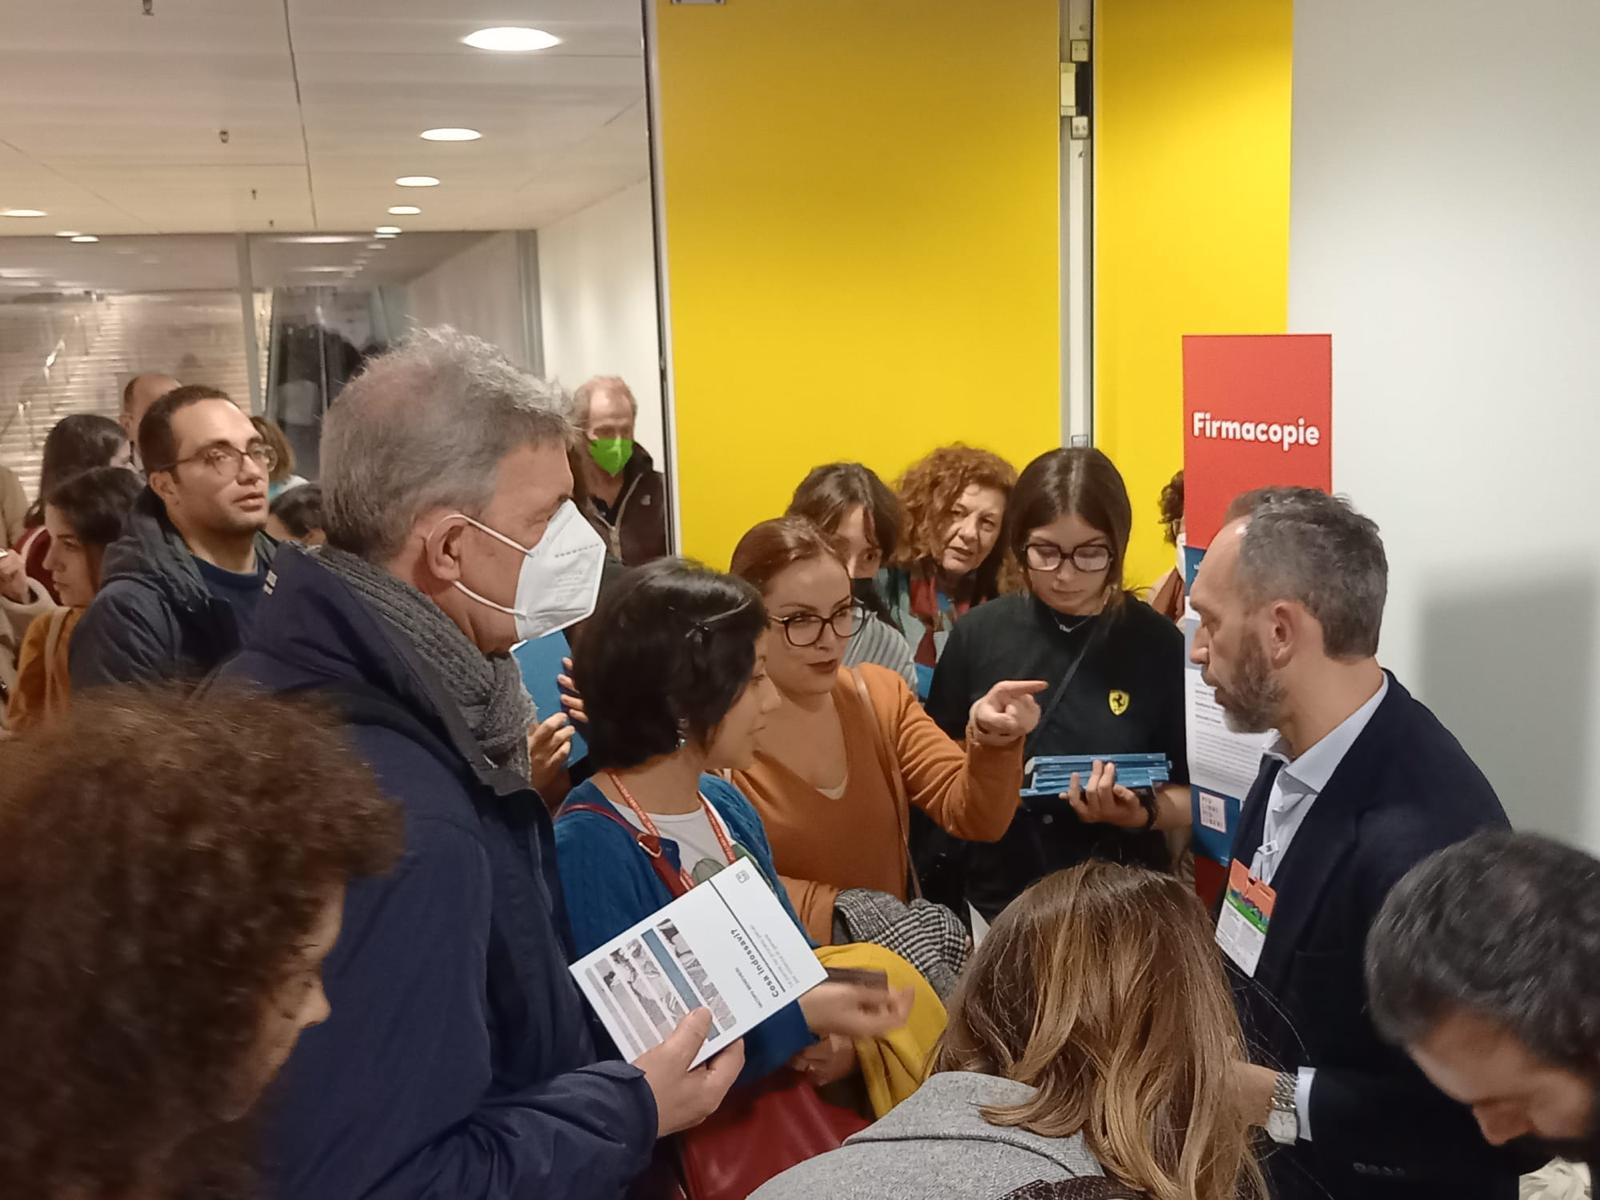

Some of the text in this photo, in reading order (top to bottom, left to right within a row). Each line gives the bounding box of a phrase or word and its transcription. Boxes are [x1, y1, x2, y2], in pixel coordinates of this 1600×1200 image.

[1192, 411, 1321, 452] Firmacopie
[730, 928, 765, 976] indossavi?
[763, 974, 779, 998] Cosa
